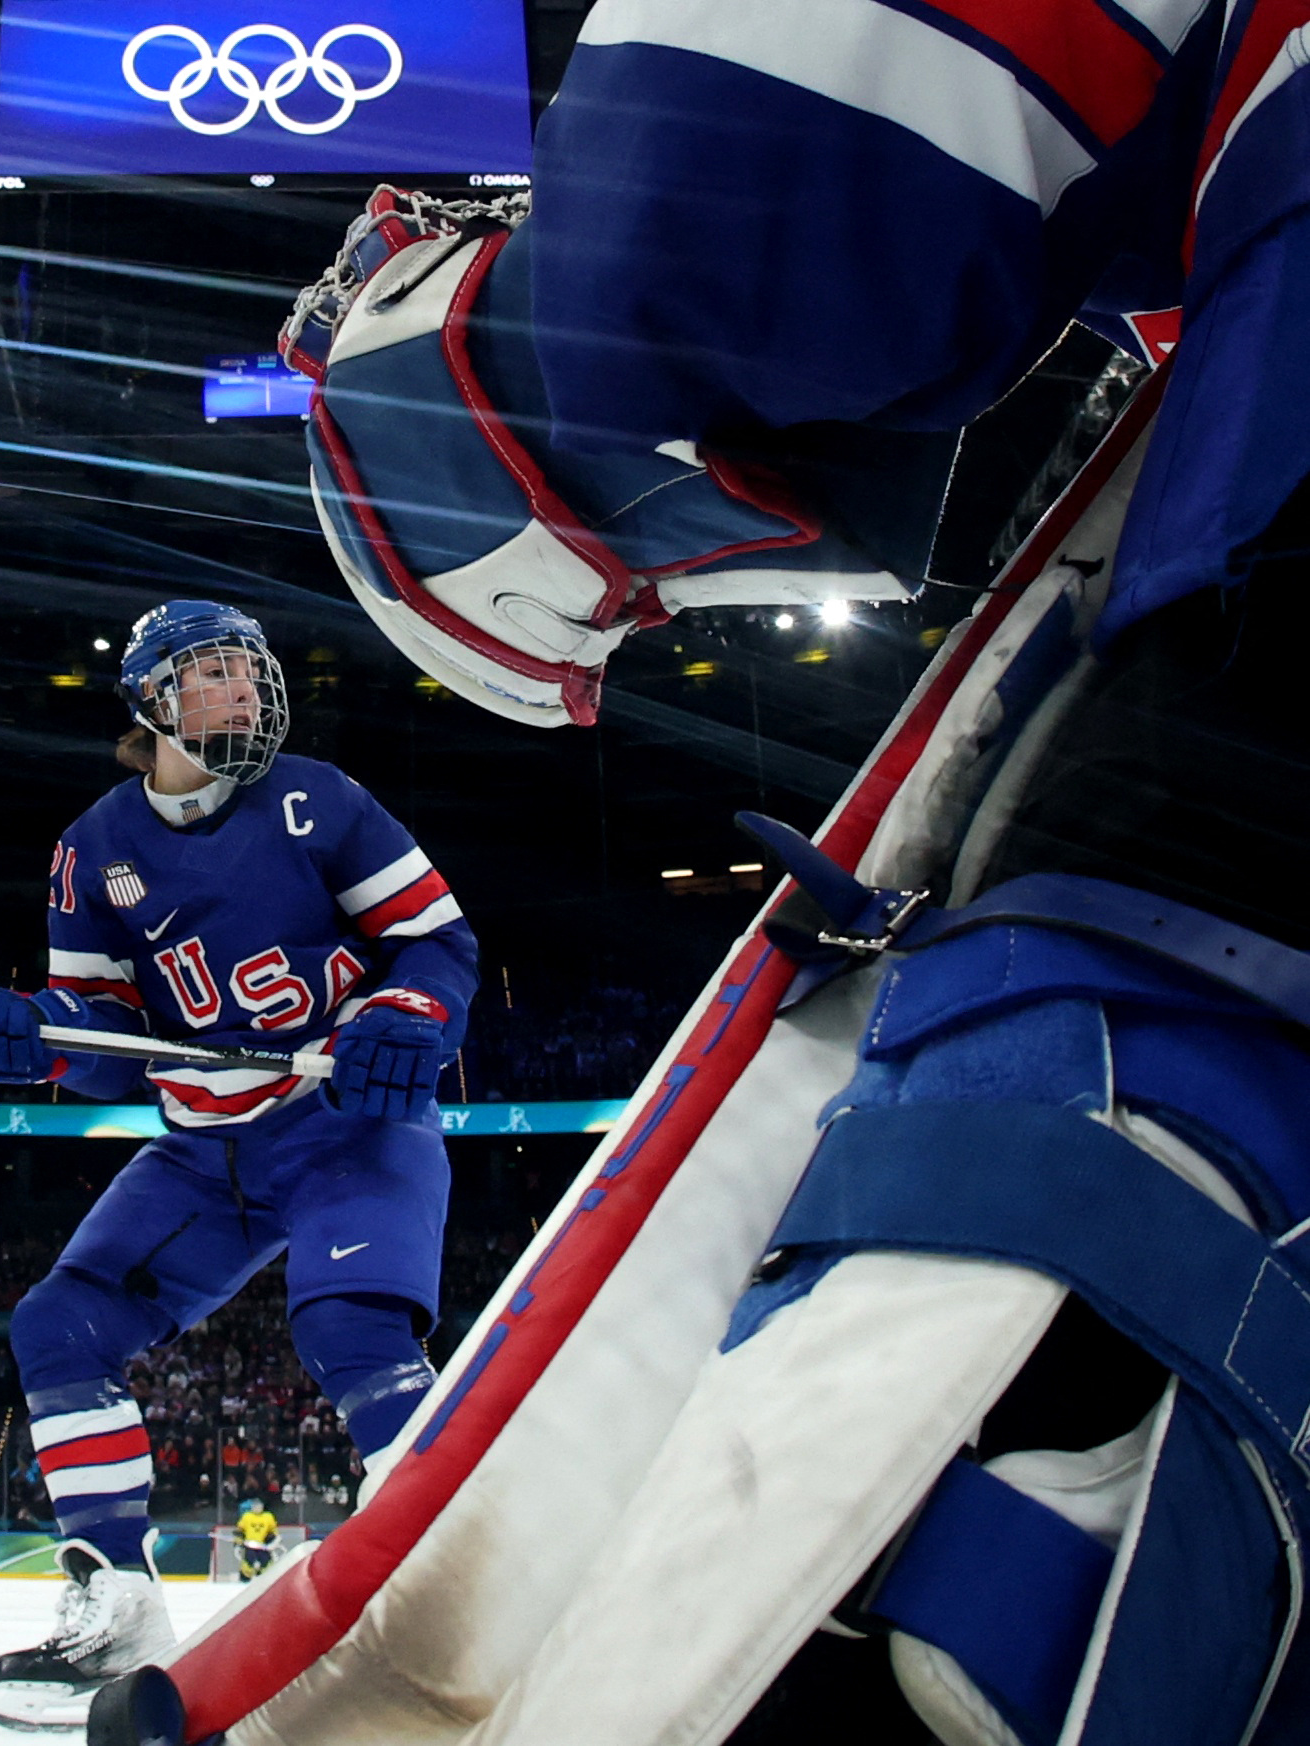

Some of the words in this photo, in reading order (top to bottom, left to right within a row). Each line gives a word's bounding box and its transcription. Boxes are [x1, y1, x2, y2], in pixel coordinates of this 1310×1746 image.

[483, 174, 531, 187] OMEGA
[282, 791, 314, 836] C
[106, 864, 131, 878] USA
[153, 936, 366, 1031] USA
